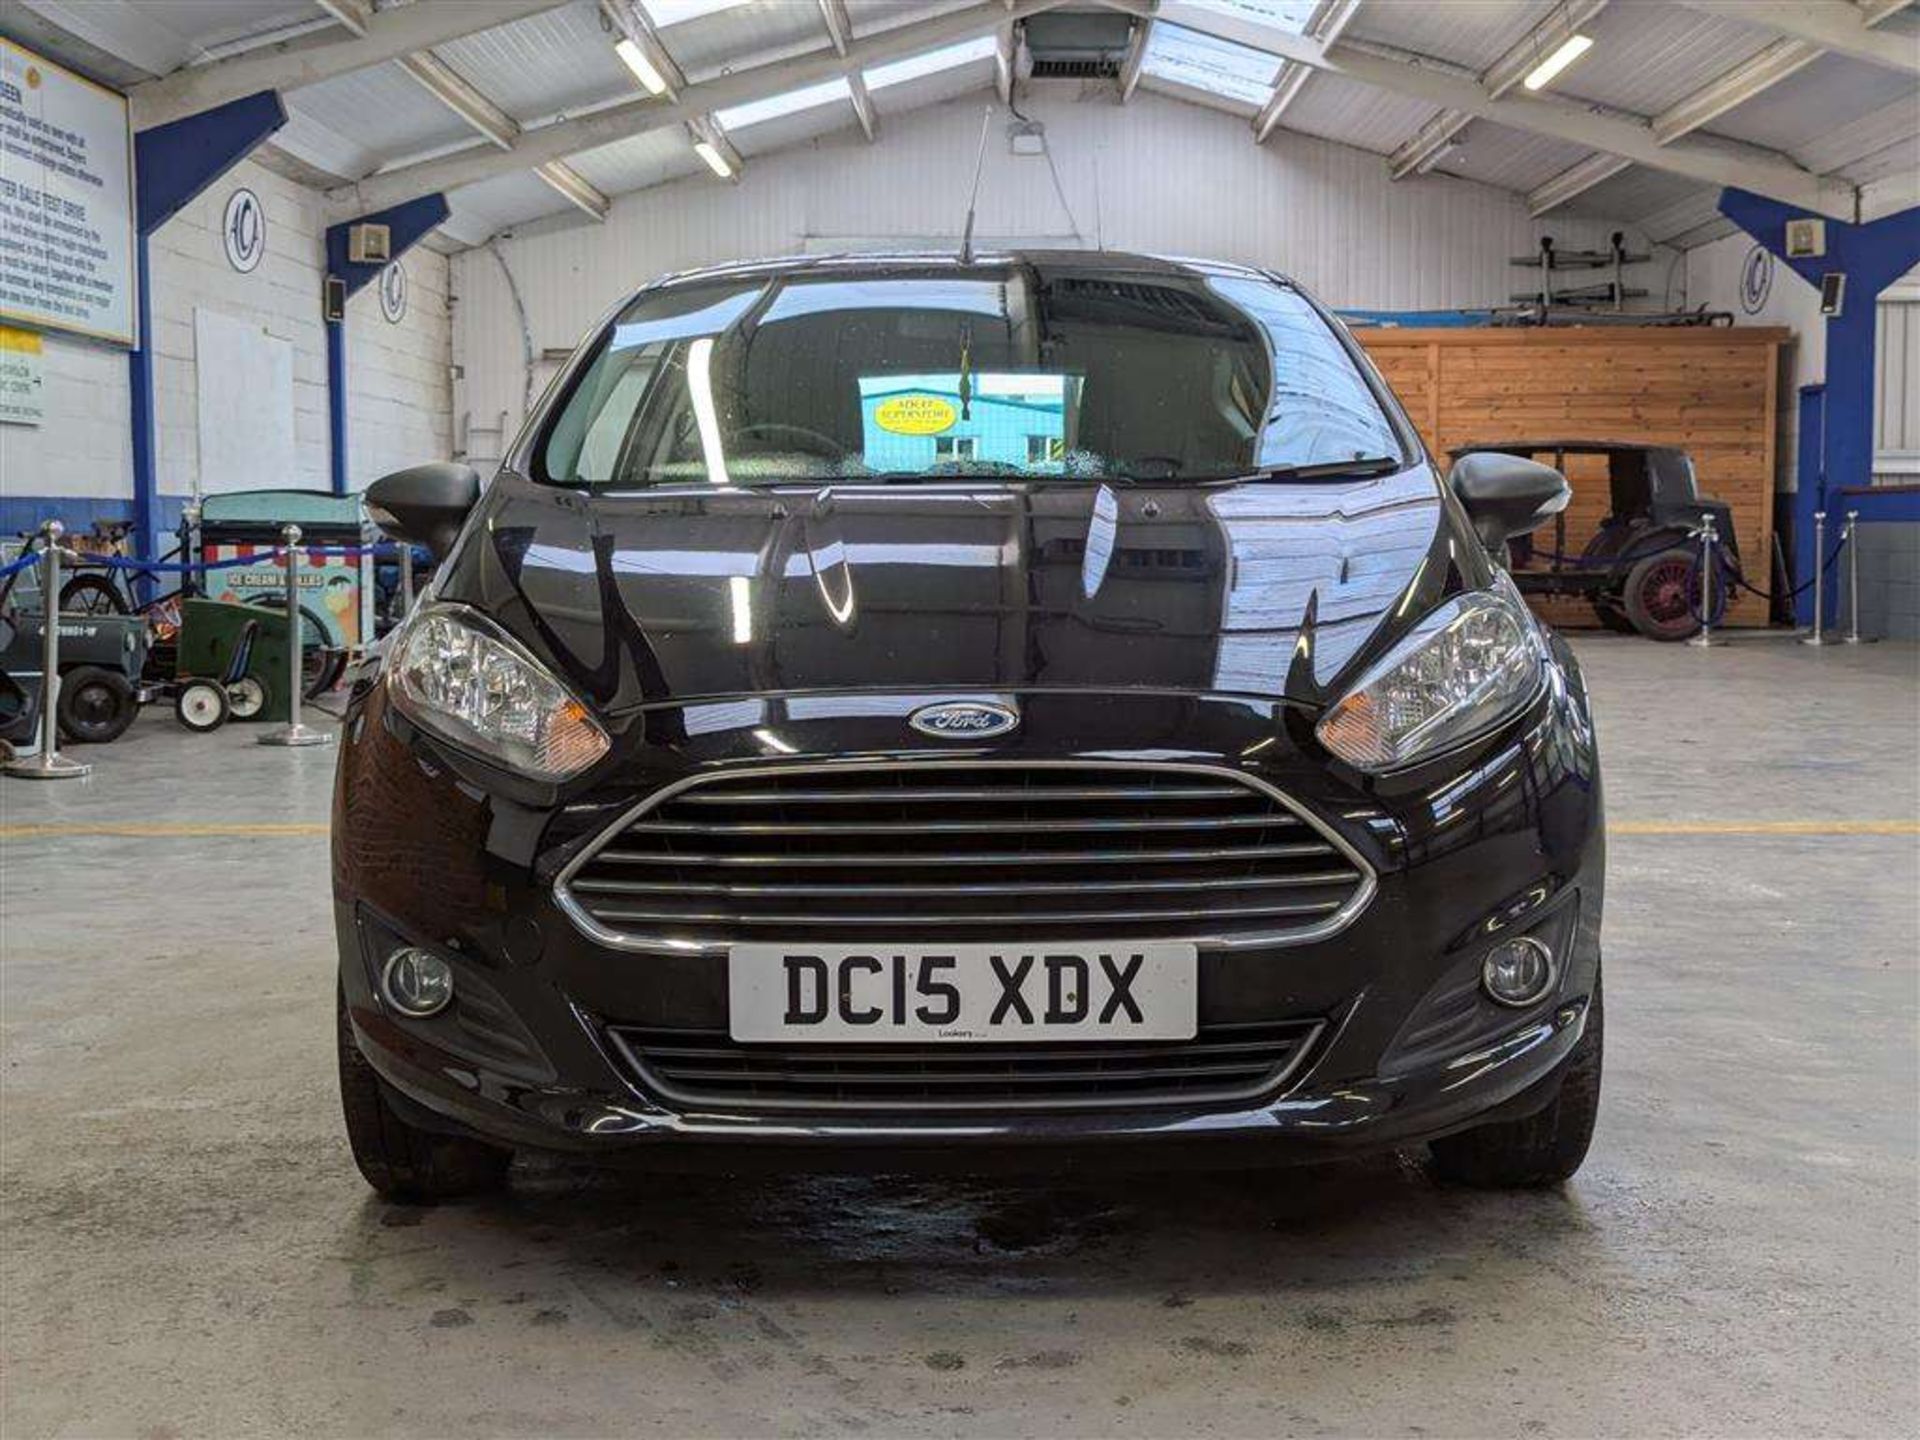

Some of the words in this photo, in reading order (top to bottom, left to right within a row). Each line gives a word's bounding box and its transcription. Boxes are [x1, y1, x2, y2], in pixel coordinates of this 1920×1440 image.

[244, 573, 277, 586] CREAM
[935, 710, 991, 729] Ford
[784, 956, 960, 1025] DC15
[990, 955, 1144, 1025] XDX
